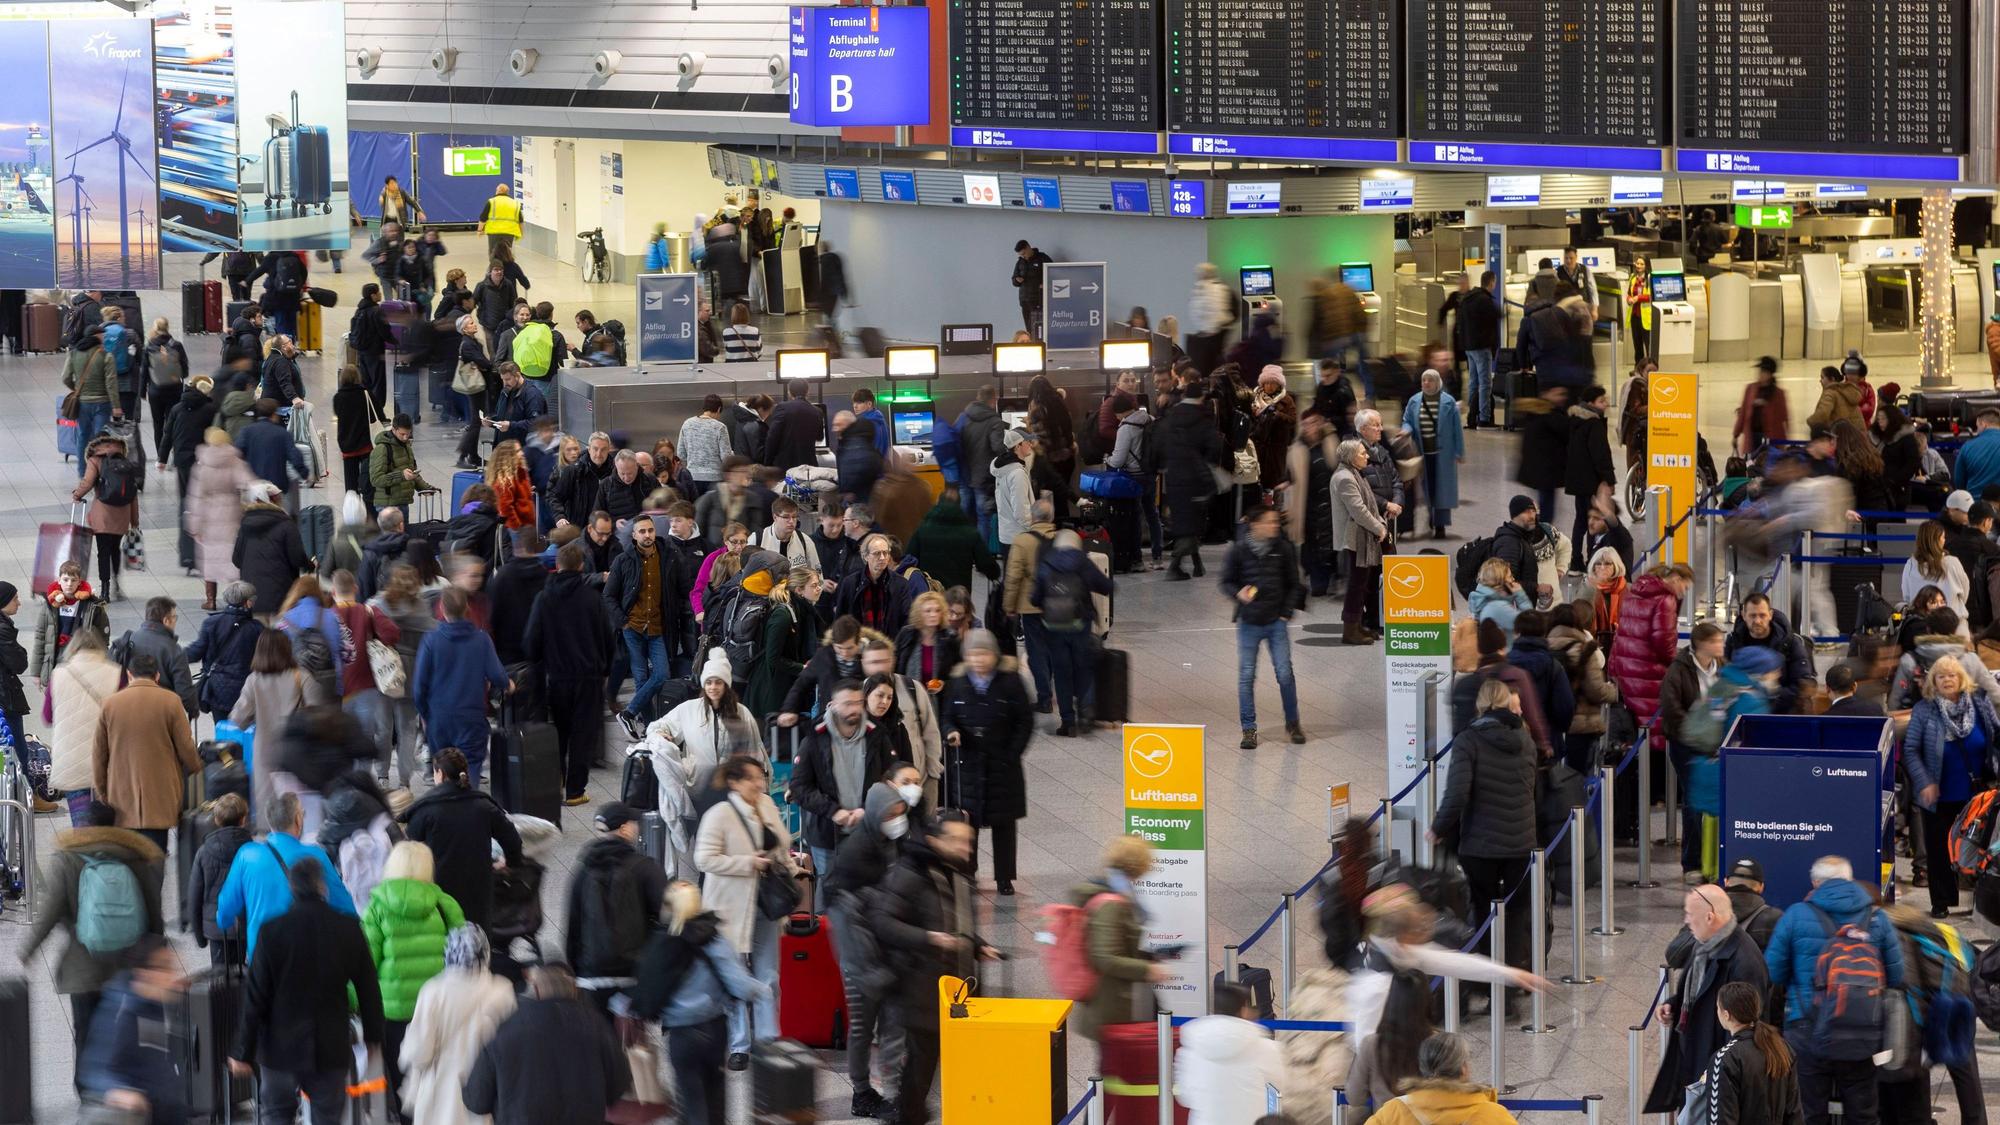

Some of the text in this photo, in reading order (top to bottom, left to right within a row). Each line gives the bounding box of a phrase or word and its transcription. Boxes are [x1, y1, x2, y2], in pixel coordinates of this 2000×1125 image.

[1740, 3, 1765, 11] TRIEST
[829, 17, 877, 27] Terminal 1
[1739, 14, 1773, 22] BUDAPEST
[1740, 25, 1765, 33] ZAGREB
[829, 35, 880, 46] Abflughalle
[1739, 35, 1769, 43] BOLOGNA
[108, 47, 142, 60] Fraport
[829, 48, 895, 60] Departures hall
[1739, 46, 1773, 54] SALZBURG
[792, 72, 799, 110] B
[1484, 84, 1499, 92] KONG
[831, 74, 853, 113] B
[1465, 93, 1488, 101] VERONA
[1465, 103, 1492, 111] FLORENZ
[1740, 109, 1777, 118] LANZAROTE
[1465, 123, 1484, 131] SPLIT
[1740, 120, 1761, 129] TURIN
[1739, 130, 1760, 139] BASEL
[1214, 138, 1228, 146] Abflug
[1459, 146, 1474, 154] Abflug
[1459, 154, 1484, 162] Departures
[1733, 154, 1750, 163] Abflug
[1733, 163, 1760, 172] Departures
[1173, 191, 1196, 202] 428-
[1173, 203, 1191, 213] 499
[1051, 310, 1100, 328] Departures B
[1052, 310, 1074, 319] Abflug
[644, 322, 691, 341] Departures B
[645, 323, 666, 331] Abflug
[1652, 410, 1692, 419] Lufthansa
[1389, 607, 1444, 618] Lufthansa
[1390, 629, 1439, 640] Economy
[1390, 640, 1419, 650] Class
[1391, 661, 1438, 669] Gepäckabgabe
[1827, 768, 1868, 777] Lufthansa
[1131, 788, 1198, 802] Lufthansa
[1131, 815, 1192, 831] Economy
[1734, 820, 1833, 832] Bitte bedienen Sie sich
[1734, 830, 1816, 842] Please help yourself
[1146, 880, 1183, 889] Bordkarte
[1148, 889, 1180, 897] boarding
[1182, 984, 1197, 992] City
